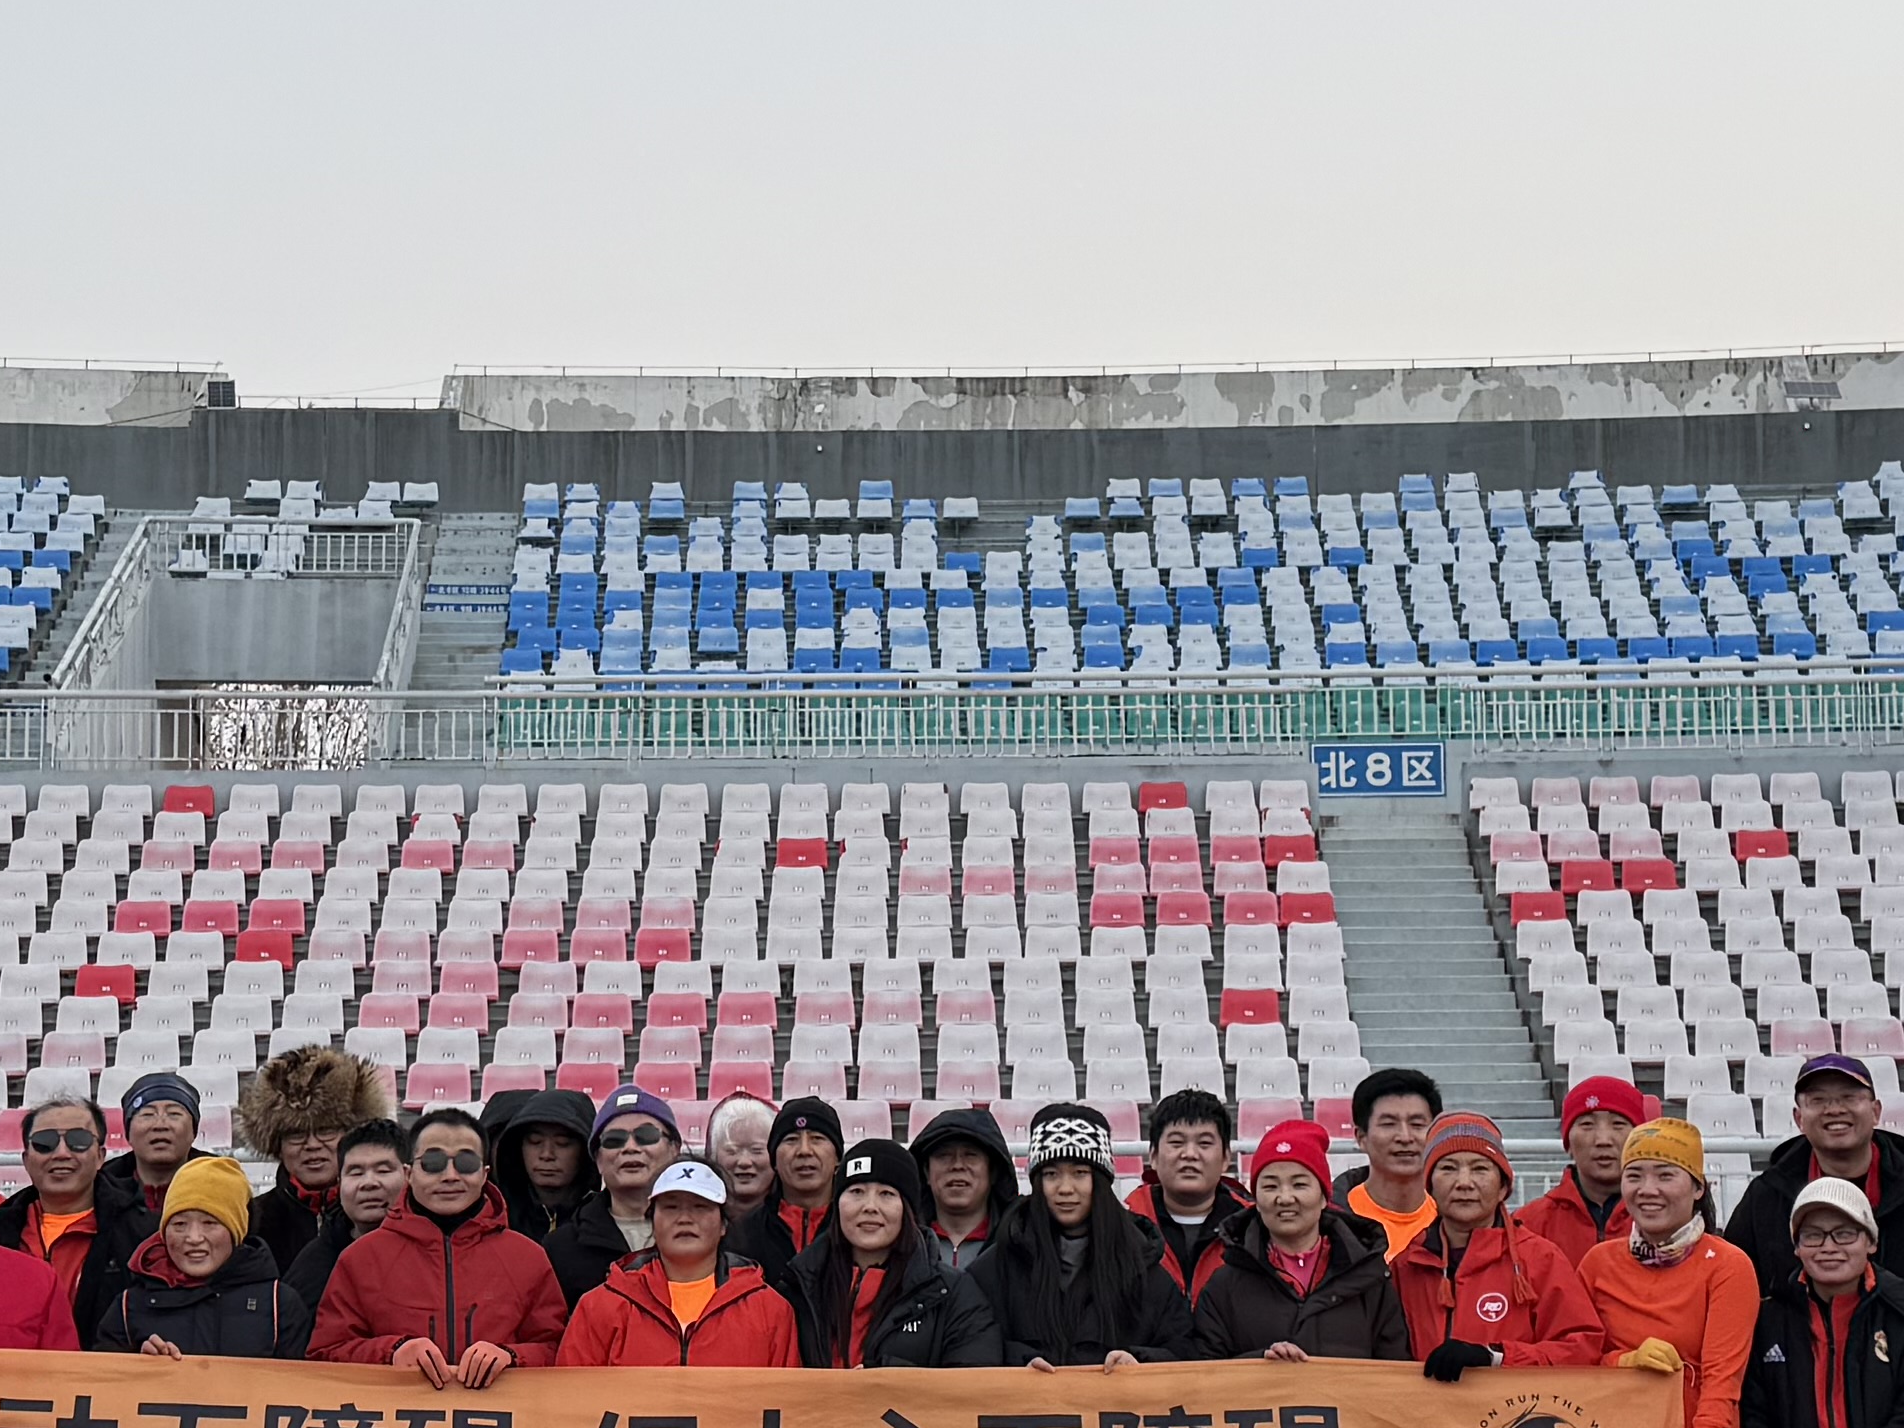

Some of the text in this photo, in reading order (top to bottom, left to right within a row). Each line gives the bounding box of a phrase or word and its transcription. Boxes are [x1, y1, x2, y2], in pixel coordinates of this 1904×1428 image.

[1321, 750, 1437, 789] 北8区
[1505, 1393, 1540, 1408] RUN
[1552, 1395, 1584, 1417] THE
